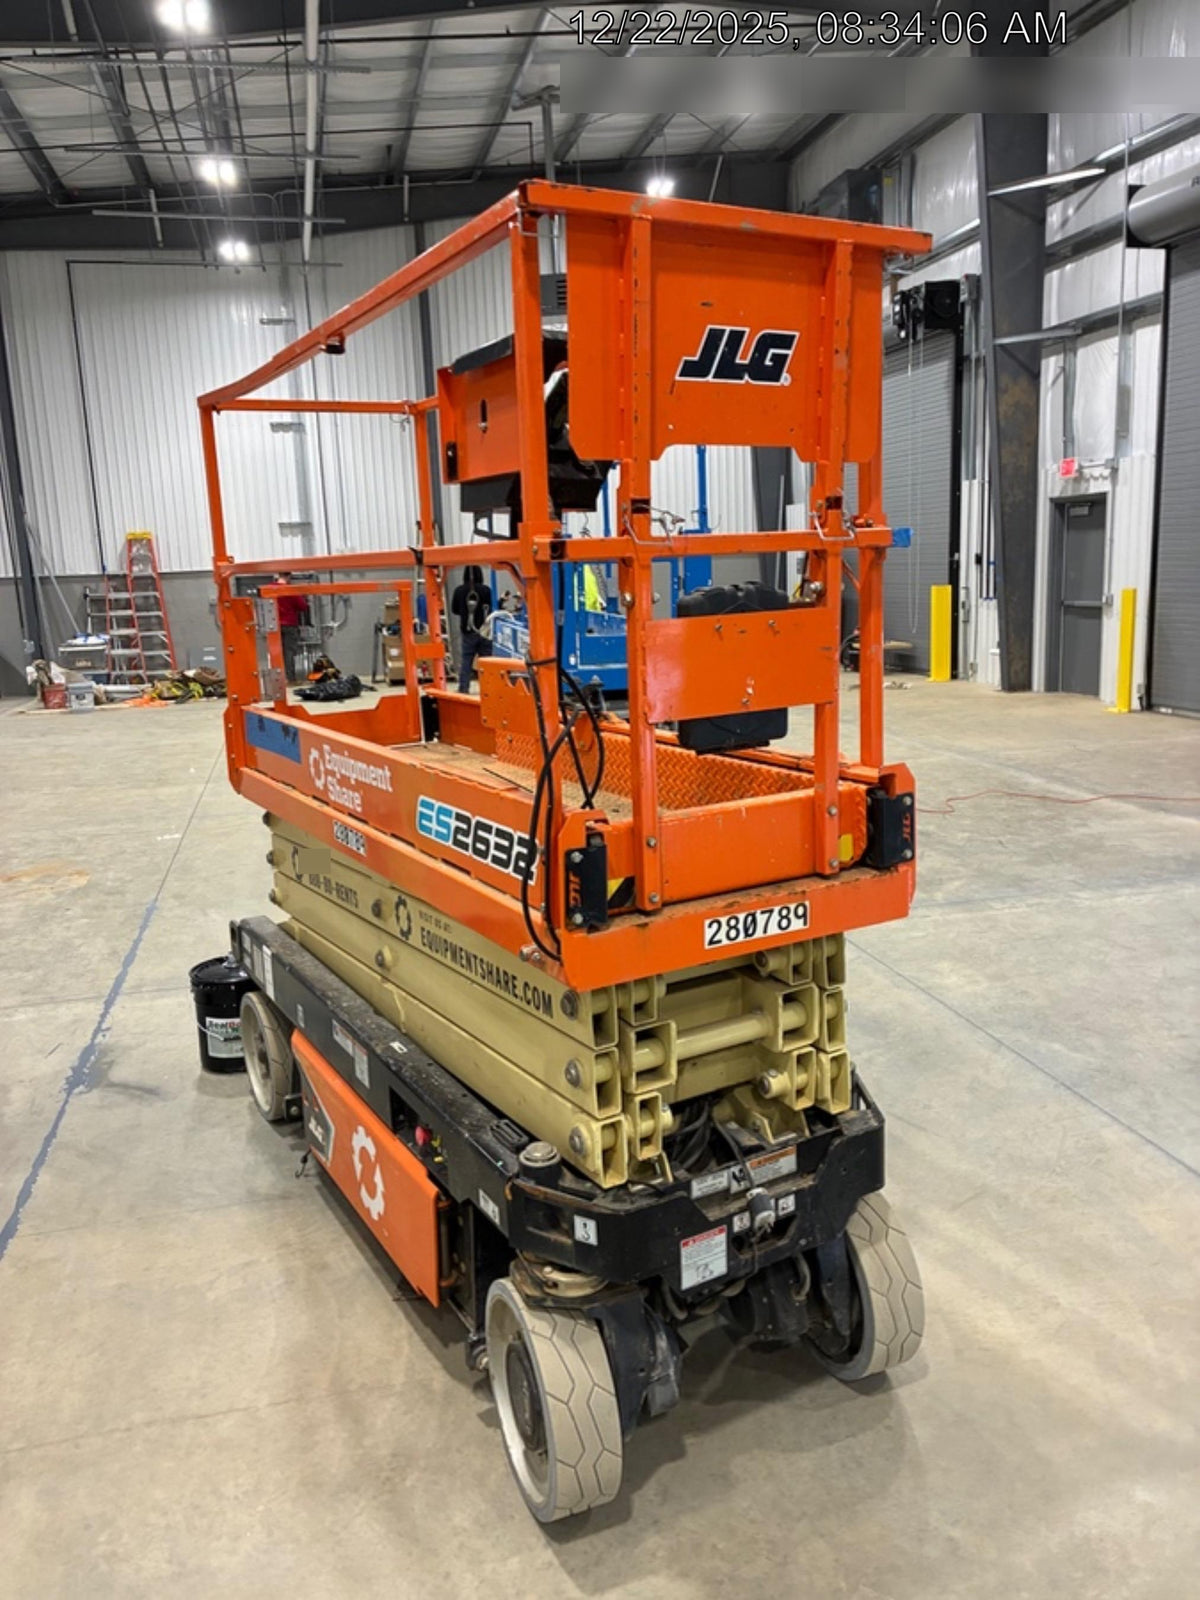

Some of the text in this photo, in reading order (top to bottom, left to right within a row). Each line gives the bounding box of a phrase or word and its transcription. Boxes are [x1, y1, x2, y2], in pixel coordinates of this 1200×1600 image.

[676, 326, 798, 385] JLG
[323, 744, 393, 793] Equipment
[326, 776, 363, 813] Share
[707, 902, 808, 946] 280789
[420, 926, 554, 1020] EQUIPMENTSHARE.COM
